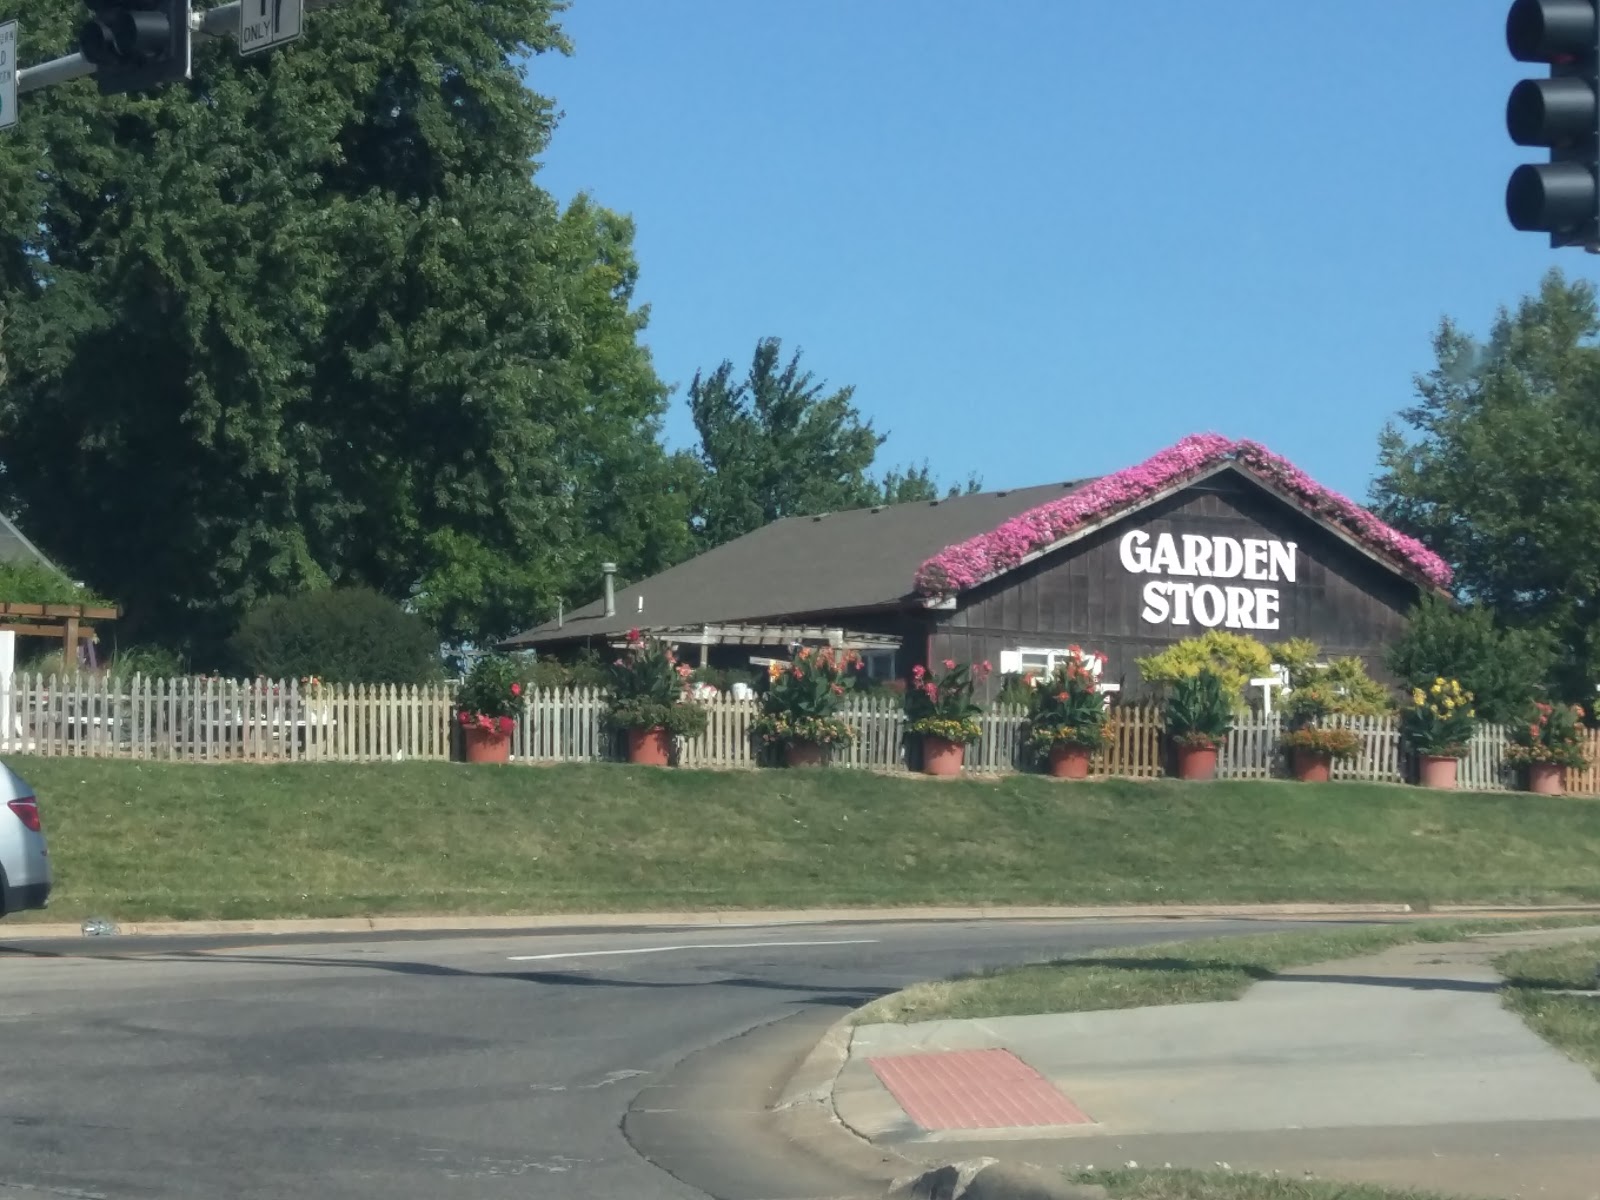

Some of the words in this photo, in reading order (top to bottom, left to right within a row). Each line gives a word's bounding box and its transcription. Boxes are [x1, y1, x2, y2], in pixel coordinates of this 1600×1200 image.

[244, 21, 270, 43] ONLY
[1119, 529, 1298, 583] GARDEN
[1141, 581, 1280, 630] STORE
